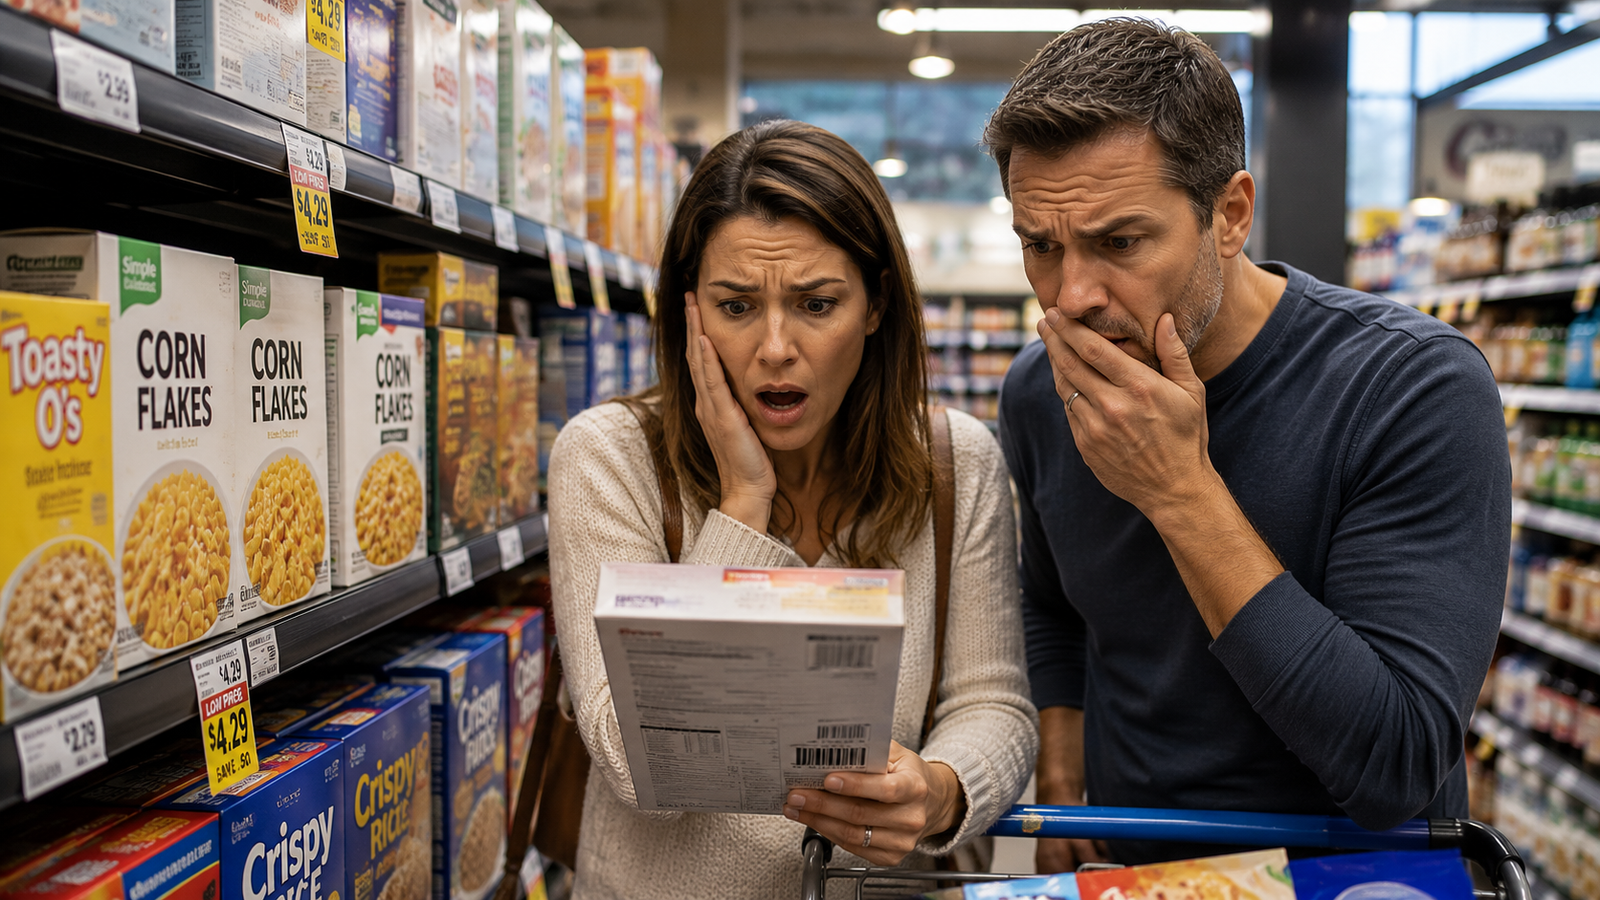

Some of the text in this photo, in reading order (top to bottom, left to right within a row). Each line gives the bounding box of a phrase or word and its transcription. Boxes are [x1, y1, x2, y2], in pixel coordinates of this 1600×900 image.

[297, 188, 328, 227] $4.29
[122, 256, 157, 279] Simple
[242, 280, 268, 299] Simple
[1, 324, 105, 397] Toasty
[137, 328, 206, 379] CORN
[251, 338, 302, 380] CORN
[376, 353, 411, 388] CORN
[36, 385, 83, 450] O's
[138, 385, 213, 430] FLAKES
[252, 385, 308, 423] FLAKES
[375, 393, 413, 424] FLAKES
[208, 707, 248, 755] $4.29
[355, 748, 417, 828] Crispy
[242, 805, 334, 900] Crispy
